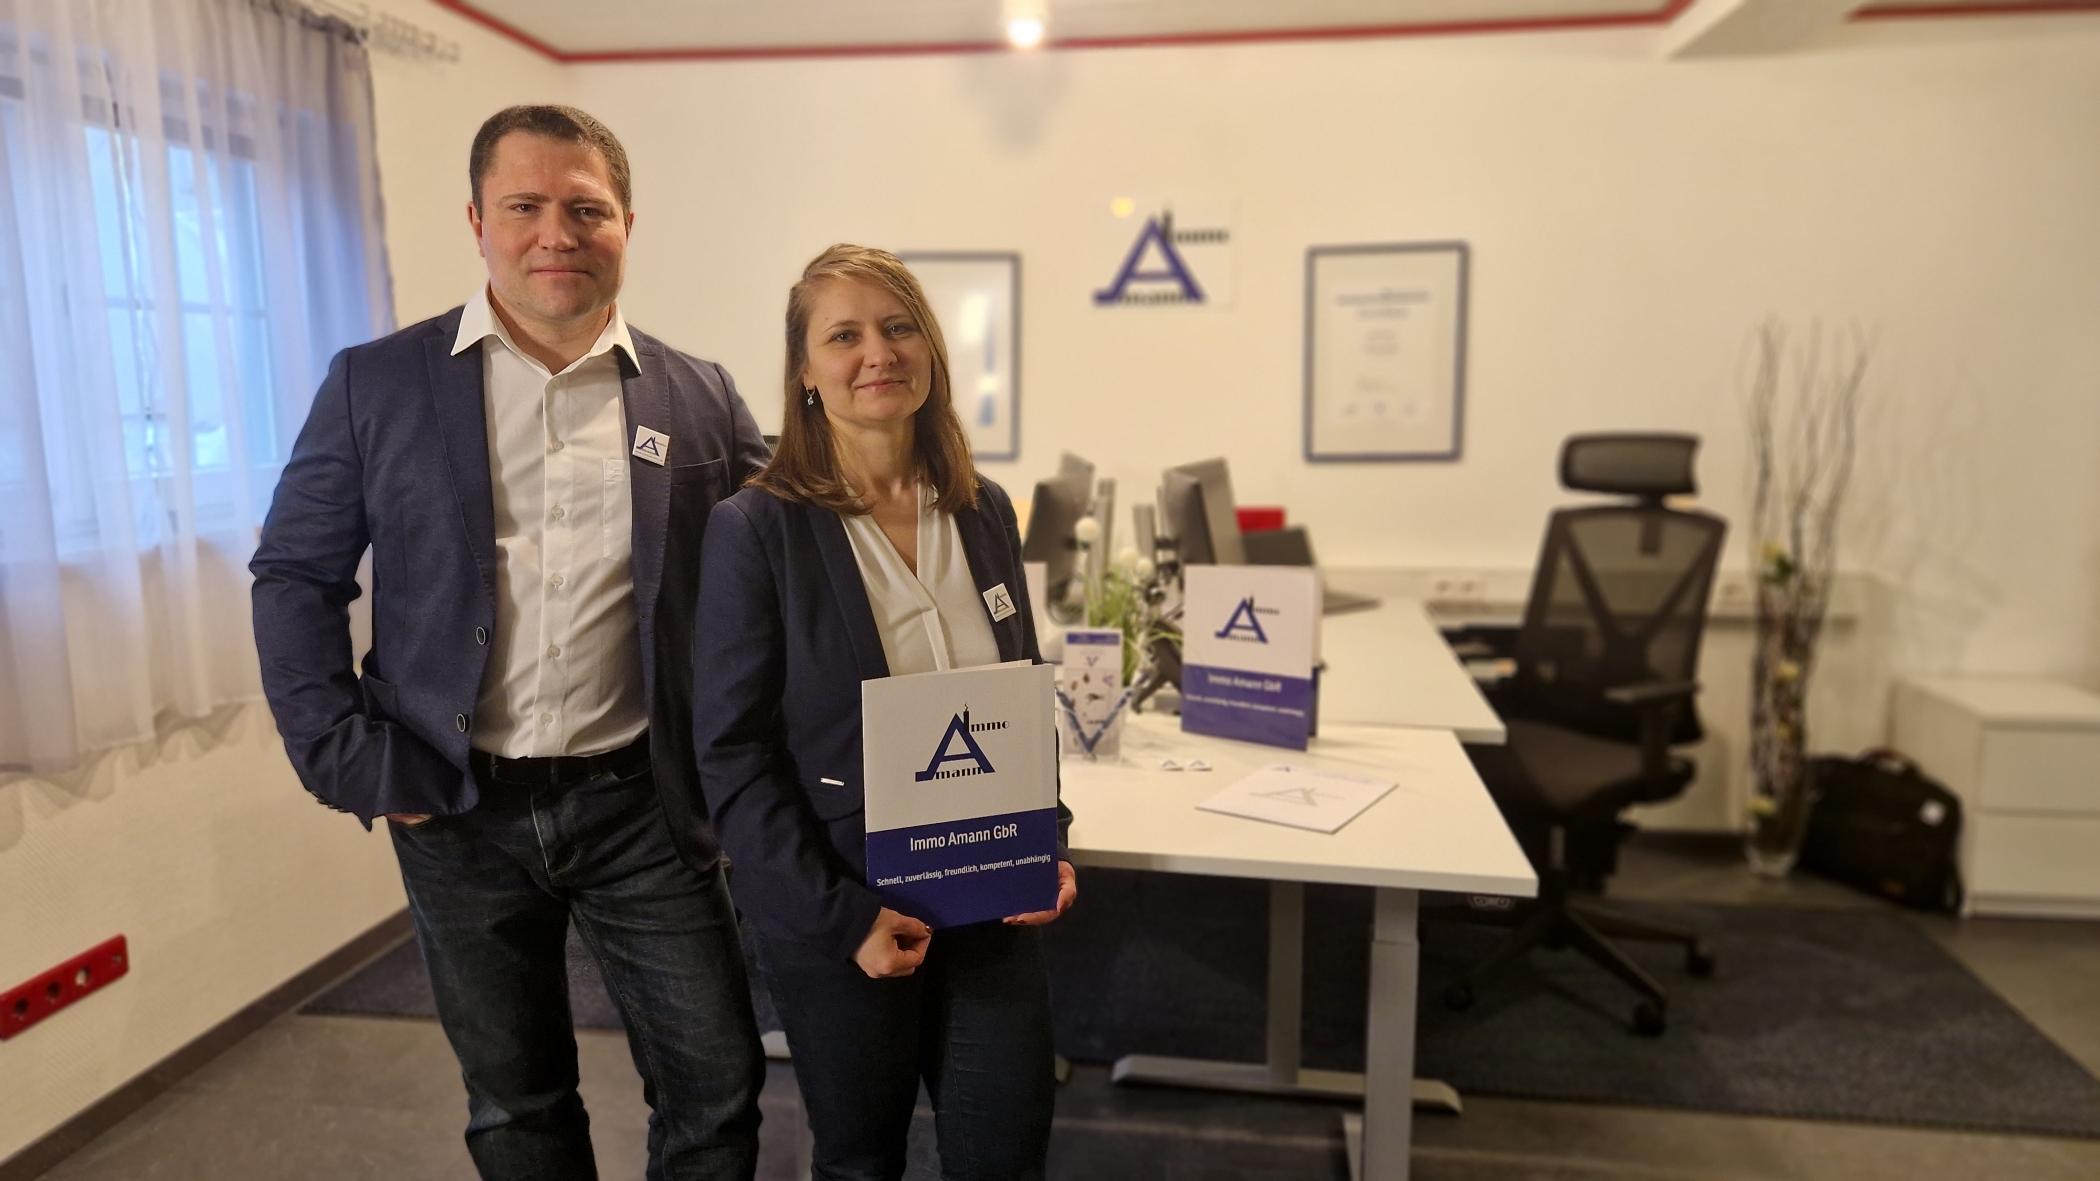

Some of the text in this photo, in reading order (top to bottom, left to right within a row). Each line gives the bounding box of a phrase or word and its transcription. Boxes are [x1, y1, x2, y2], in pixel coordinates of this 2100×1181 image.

[910, 823, 1018, 851] Immo Amann GbR
[876, 853, 1051, 887] Schnell, zuverlässig, freundlich, kompetent, unabhängig
